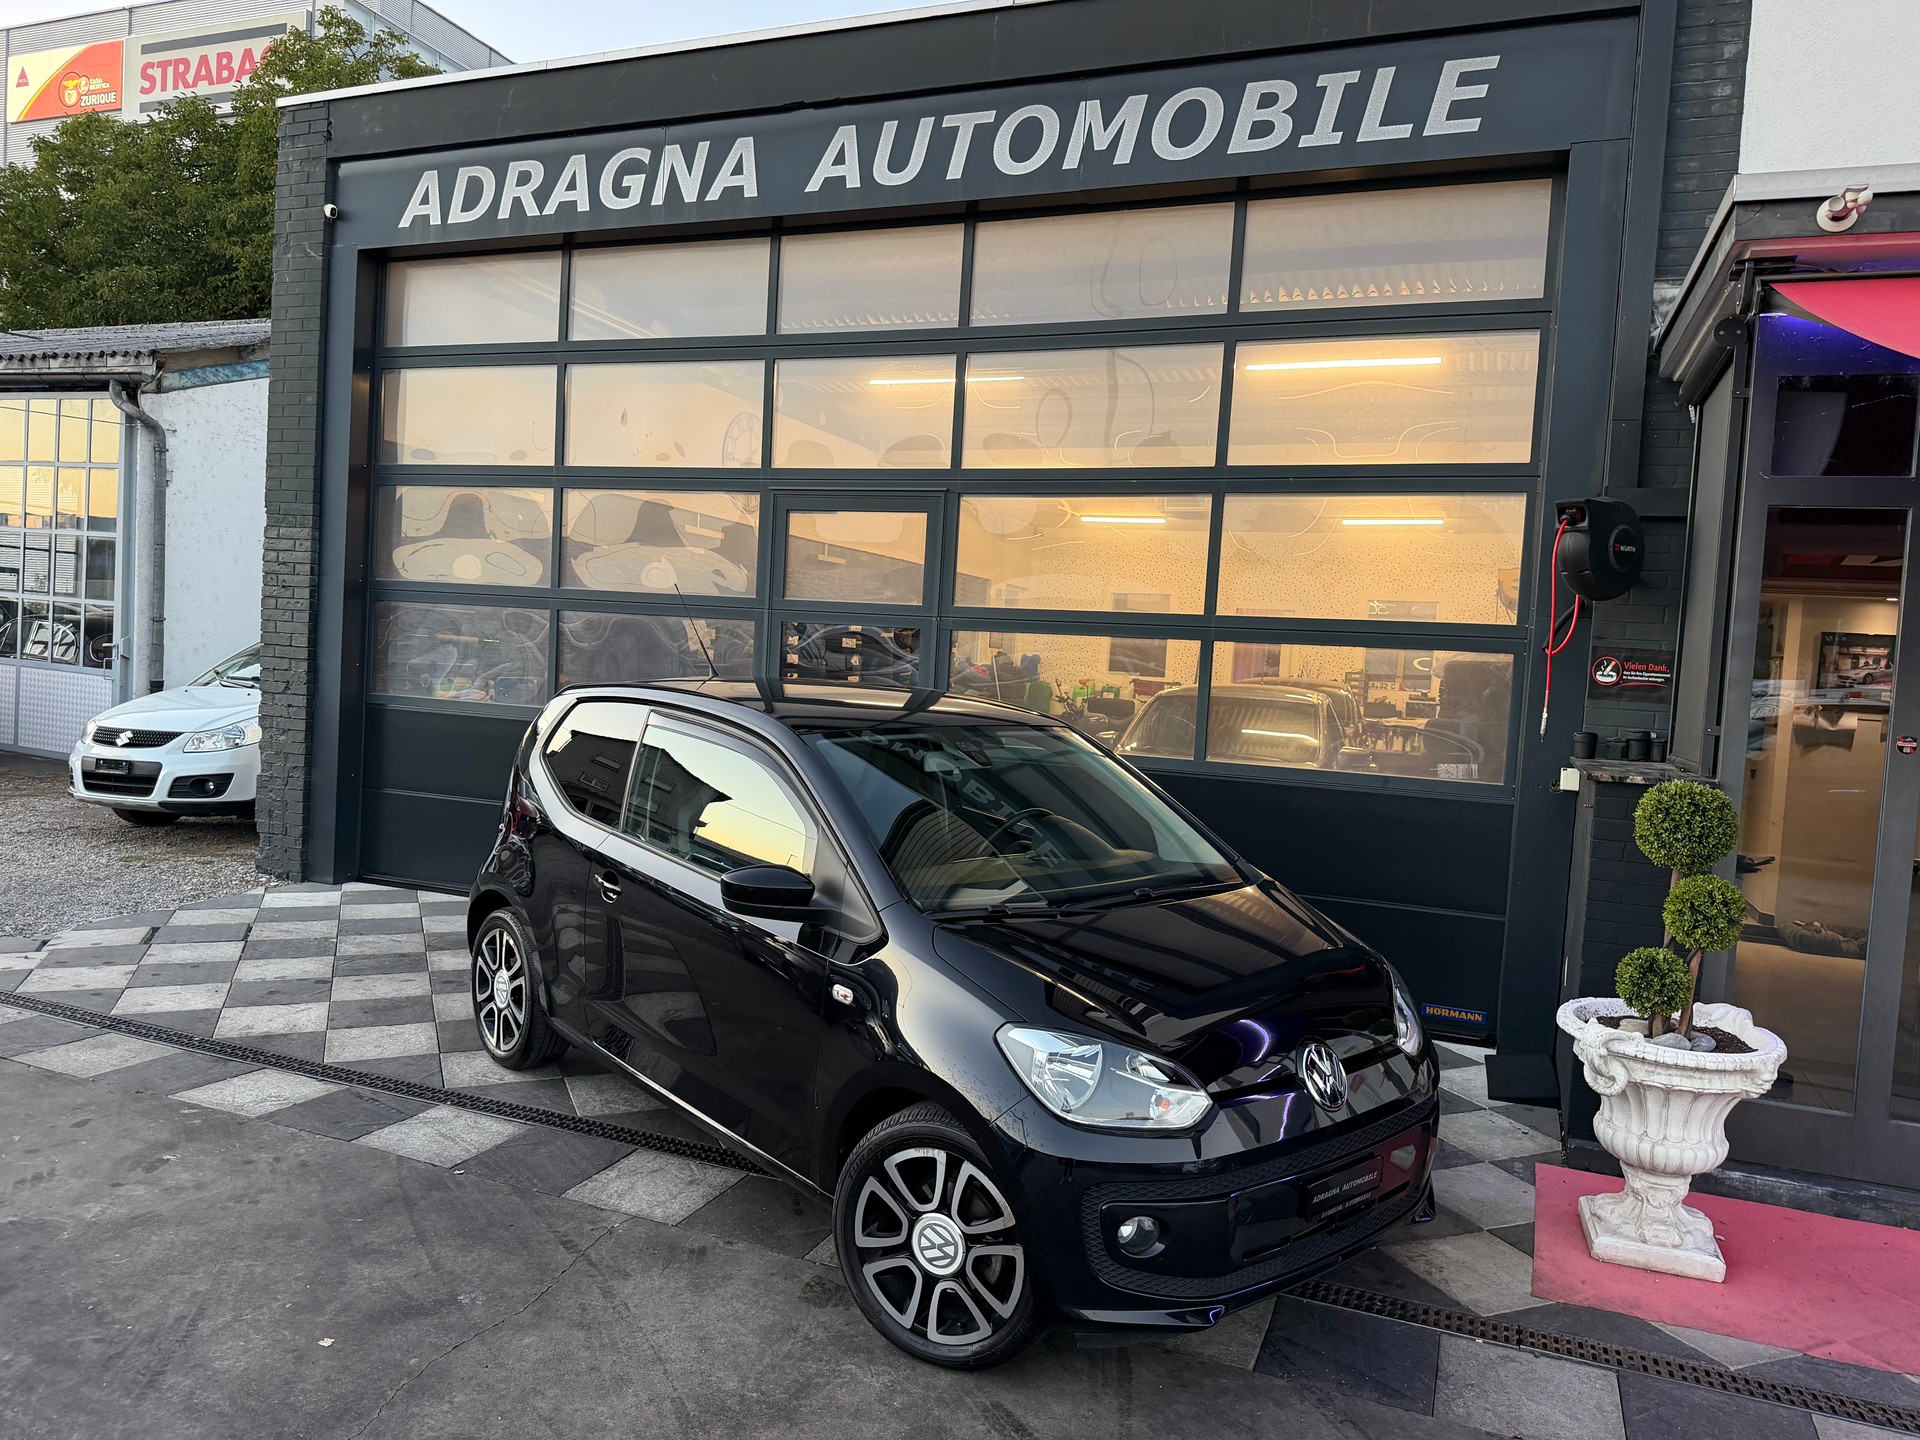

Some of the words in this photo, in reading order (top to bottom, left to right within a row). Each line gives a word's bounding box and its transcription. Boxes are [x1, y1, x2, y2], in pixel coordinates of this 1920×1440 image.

[81, 92, 117, 106] ZURIQUE
[398, 137, 759, 229] ADRAGNA
[804, 55, 1501, 193] AUTOMOBILE
[1624, 662, 1647, 670] Vielen
[1425, 1006, 1483, 1022] HÖRMANN
[1312, 1186, 1340, 1204] ADRAGNA
[1341, 1171, 1378, 1192] AUTOMOBILE
